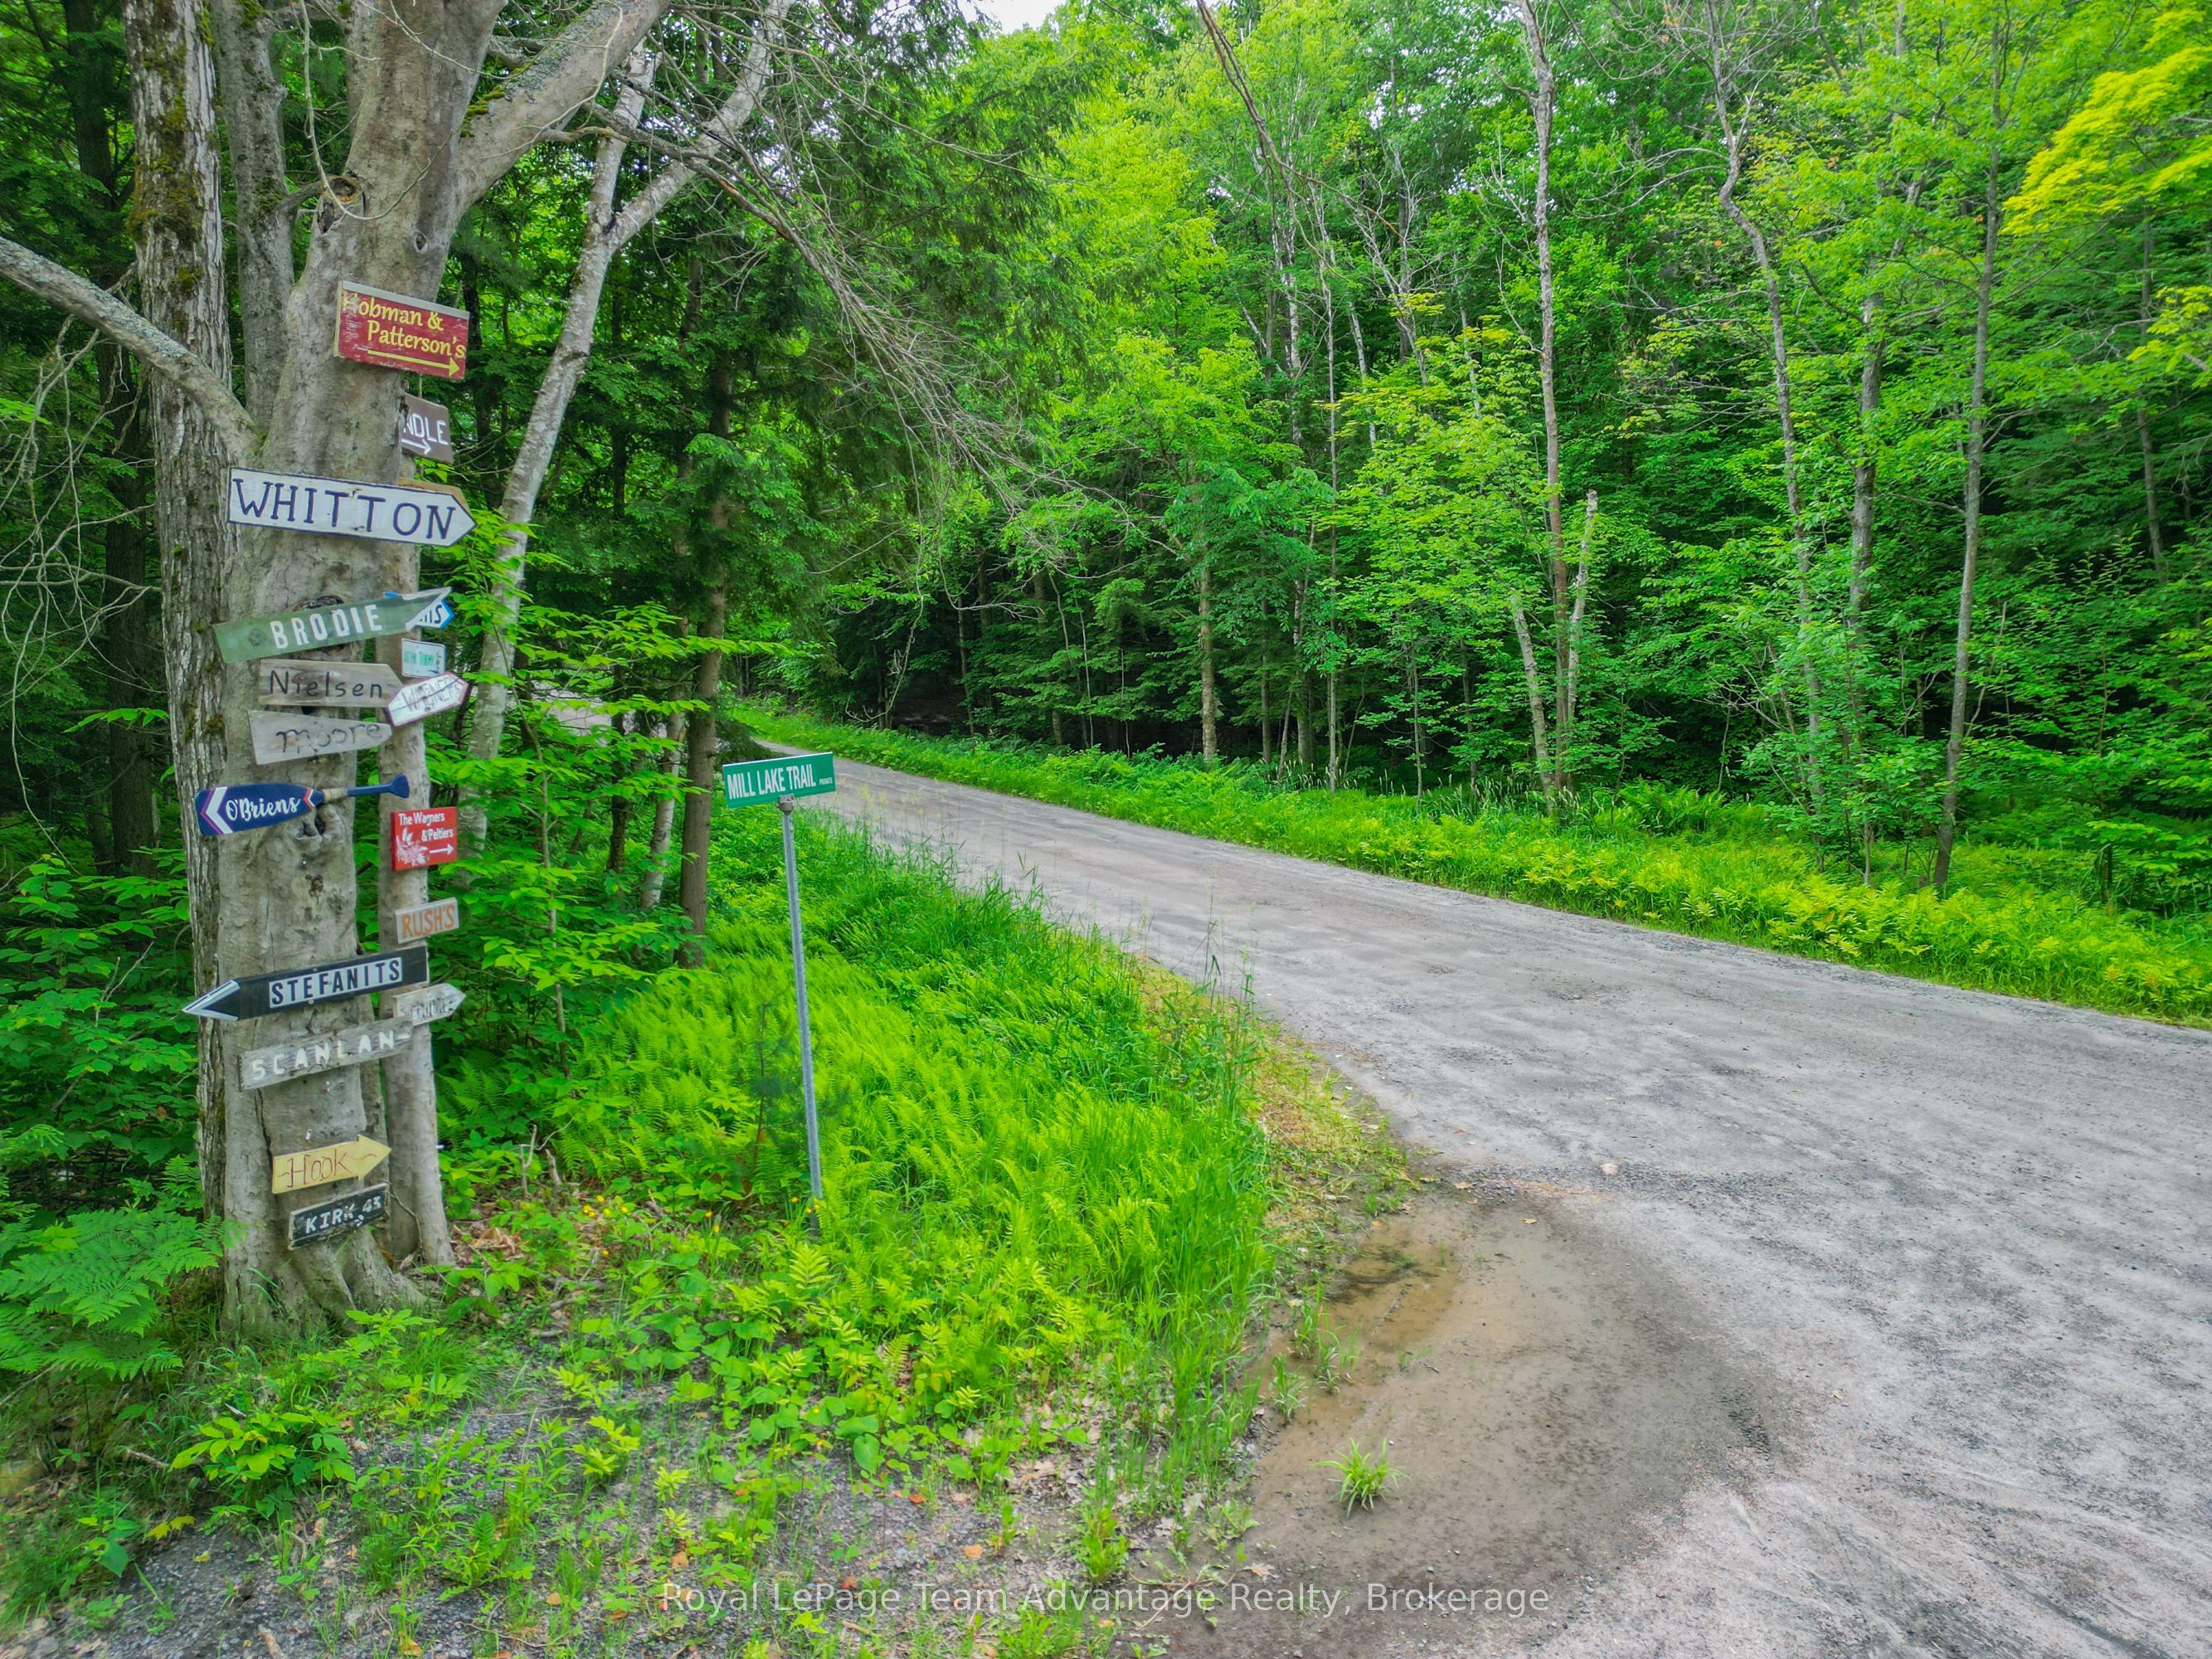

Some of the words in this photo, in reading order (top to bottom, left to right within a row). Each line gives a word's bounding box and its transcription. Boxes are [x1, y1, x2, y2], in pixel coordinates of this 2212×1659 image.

[427, 310, 445, 331] &
[367, 319, 467, 359] Patterson's
[233, 479, 456, 539] WHITTON
[270, 604, 382, 649] BRODIE
[270, 669, 383, 699] Nielsen
[727, 771, 756, 800] MILL
[756, 767, 786, 795] LAKE
[786, 763, 817, 790] TRAIL
[225, 795, 302, 824] O'Briens
[398, 812, 412, 826] The
[413, 812, 445, 826] Wagners
[401, 904, 456, 939] RUSH'S
[271, 959, 401, 1005] STEFANITS
[304, 1201, 356, 1235] KIRK
